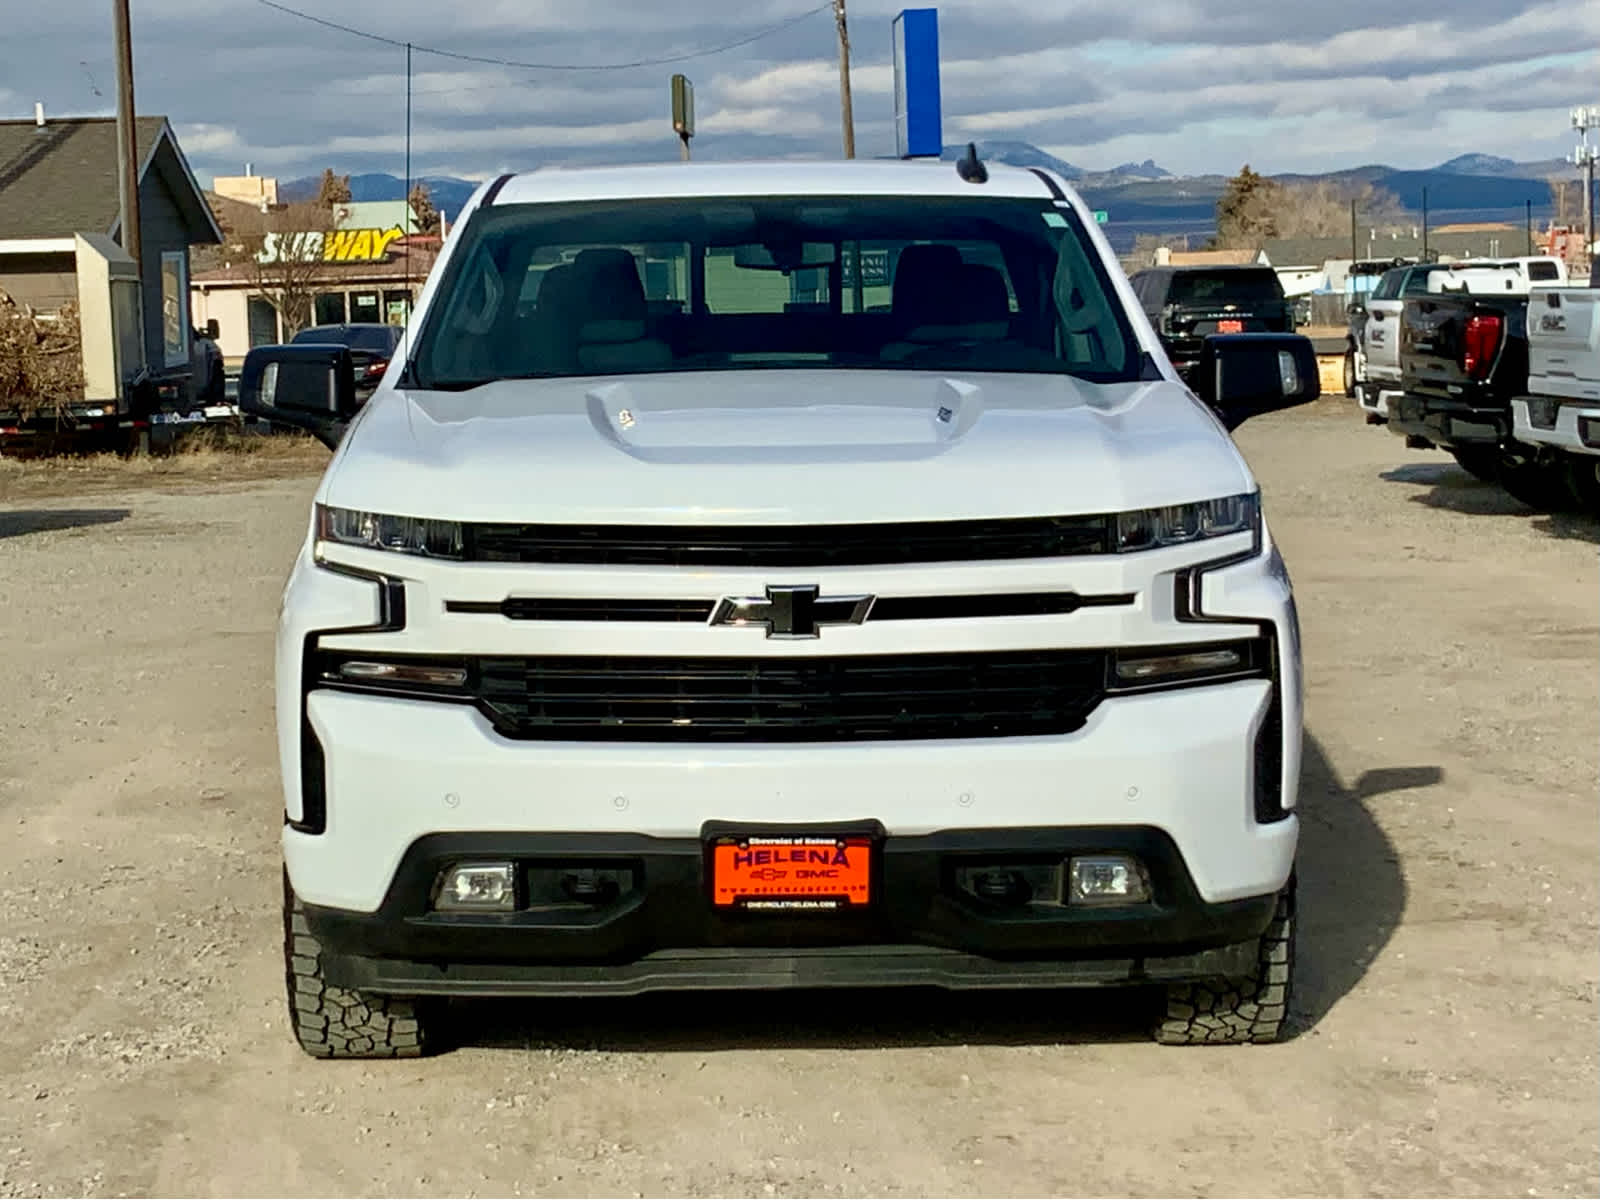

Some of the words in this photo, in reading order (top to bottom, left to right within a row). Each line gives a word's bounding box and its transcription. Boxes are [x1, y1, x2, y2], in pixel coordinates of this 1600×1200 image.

[253, 225, 405, 264] SUBWAY
[733, 849, 850, 870] HELENA
[795, 869, 840, 879] GMC
